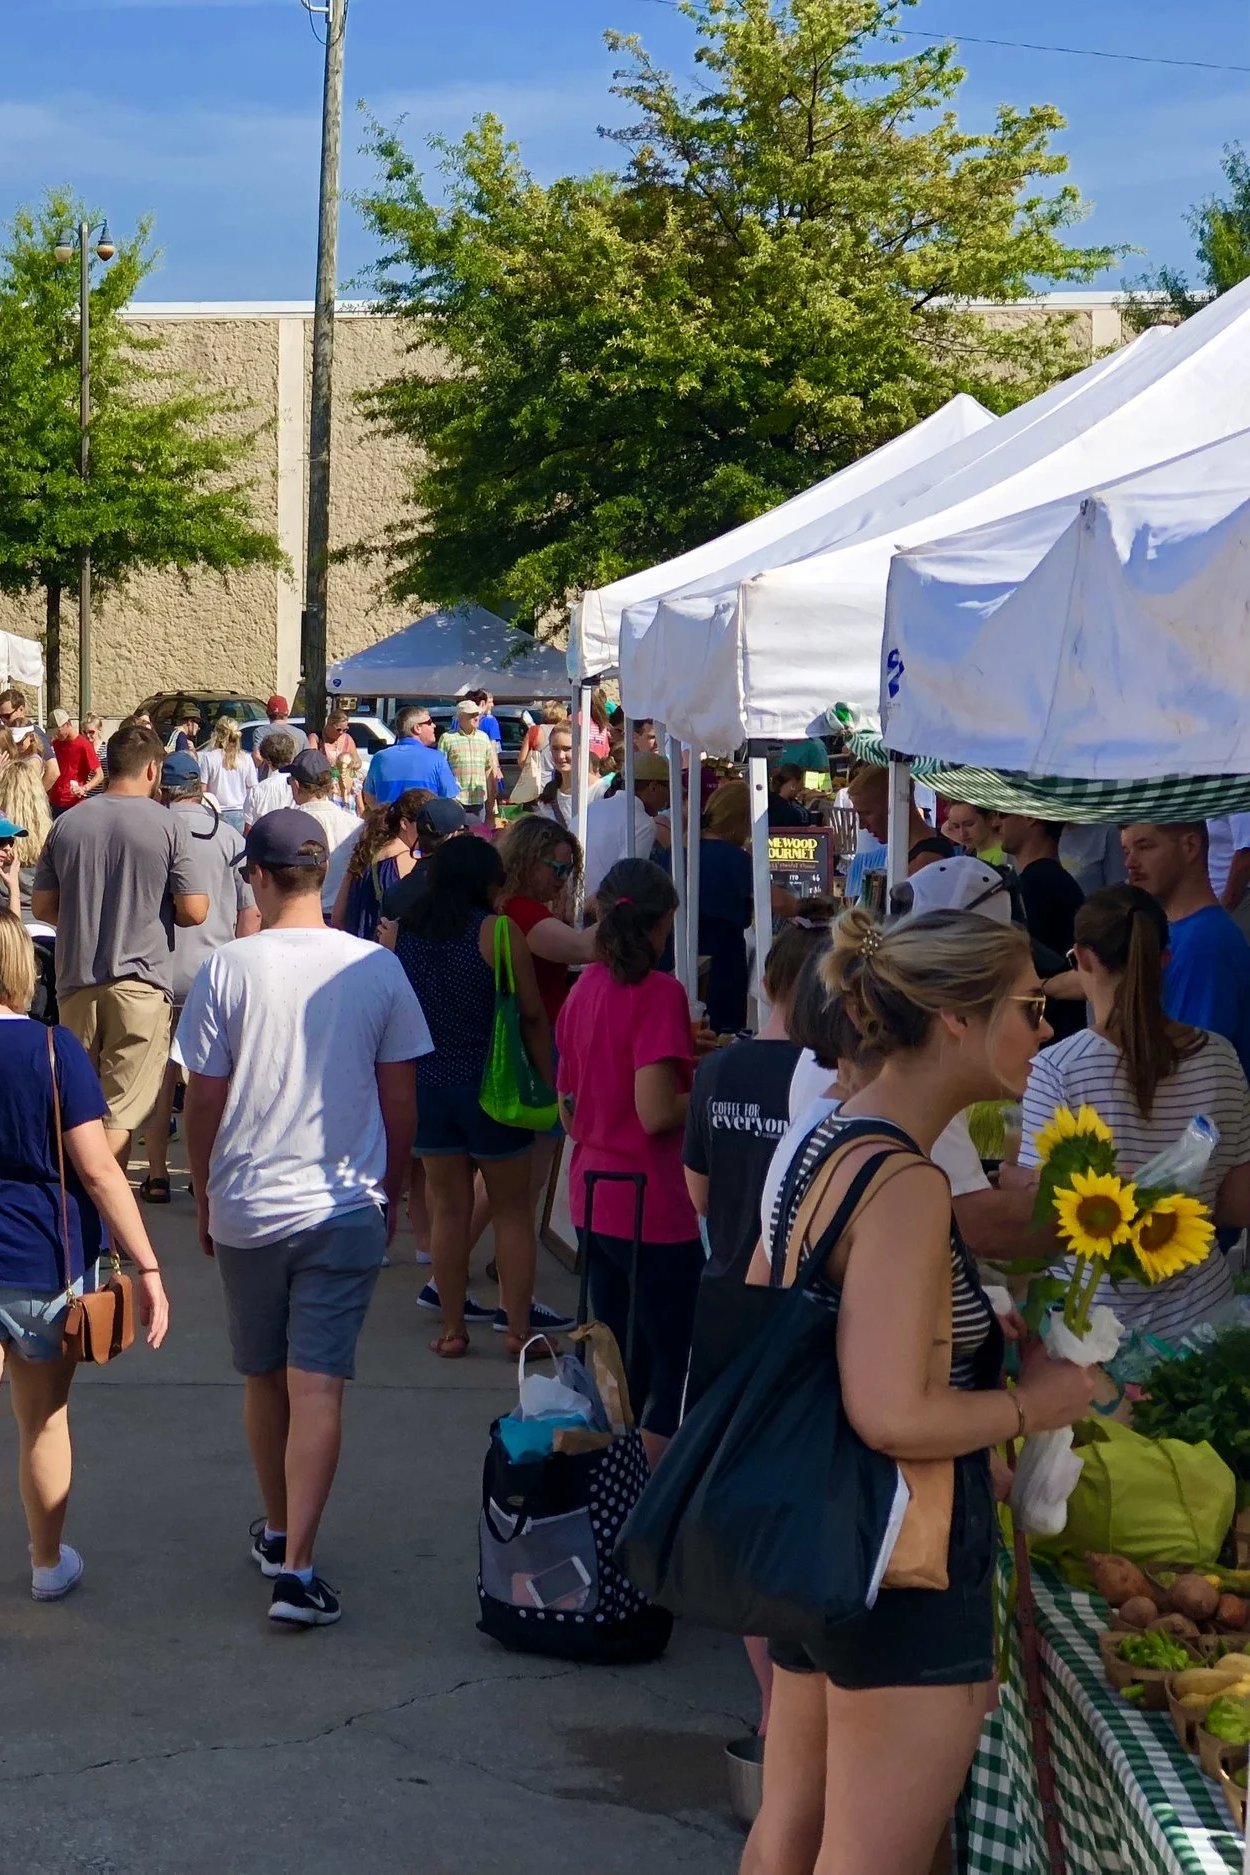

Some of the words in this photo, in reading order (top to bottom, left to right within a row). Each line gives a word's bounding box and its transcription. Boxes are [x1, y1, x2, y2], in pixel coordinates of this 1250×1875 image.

[768, 838, 817, 848] MEWOOD
[768, 848, 815, 859] OURMET
[712, 1102, 740, 1116] COFFEE
[745, 1103, 760, 1117] FOR
[712, 1115, 789, 1137] everyon
